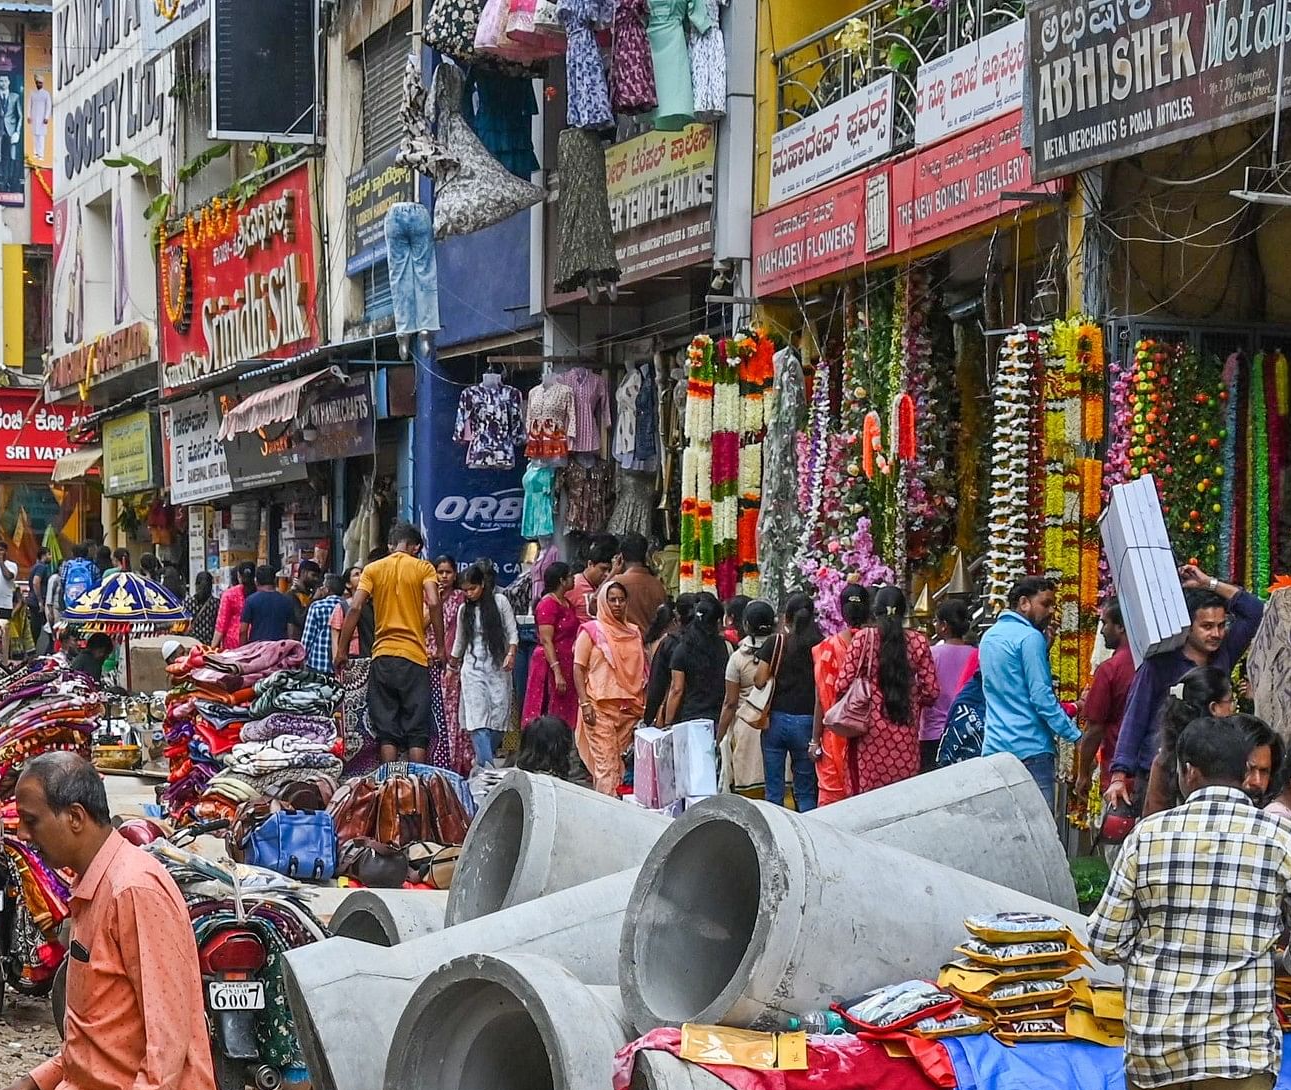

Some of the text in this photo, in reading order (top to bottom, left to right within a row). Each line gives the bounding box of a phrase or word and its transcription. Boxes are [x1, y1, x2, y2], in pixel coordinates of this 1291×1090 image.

[1038, 12, 1196, 126] ABHISHEK
[65, 72, 124, 180] SOCIETY
[1043, 134, 1068, 161] METAL
[1069, 120, 1118, 151] MERCHANTS
[1120, 122, 1127, 137] &
[1129, 113, 1153, 136] POOJA
[1156, 95, 1195, 127] ARTICLES.
[626, 181, 668, 231] TEMPLE
[667, 168, 713, 217] PALACE
[897, 204, 913, 228] THE
[913, 192, 934, 220] NEW
[935, 178, 971, 213] BOMBAY
[973, 155, 1026, 198] JEWELLERY
[686, 222, 704, 238] TEMPLE
[757, 238, 805, 276] MAHADEV
[806, 221, 856, 260] FLOWERS
[202, 273, 270, 374] Srinidhi
[269, 252, 311, 350] Silk
[6, 446, 77, 460] SRI VARA
[435, 496, 523, 521] ORB
[503, 563, 521, 573] CA
[215, 984, 260, 1008] 6007
